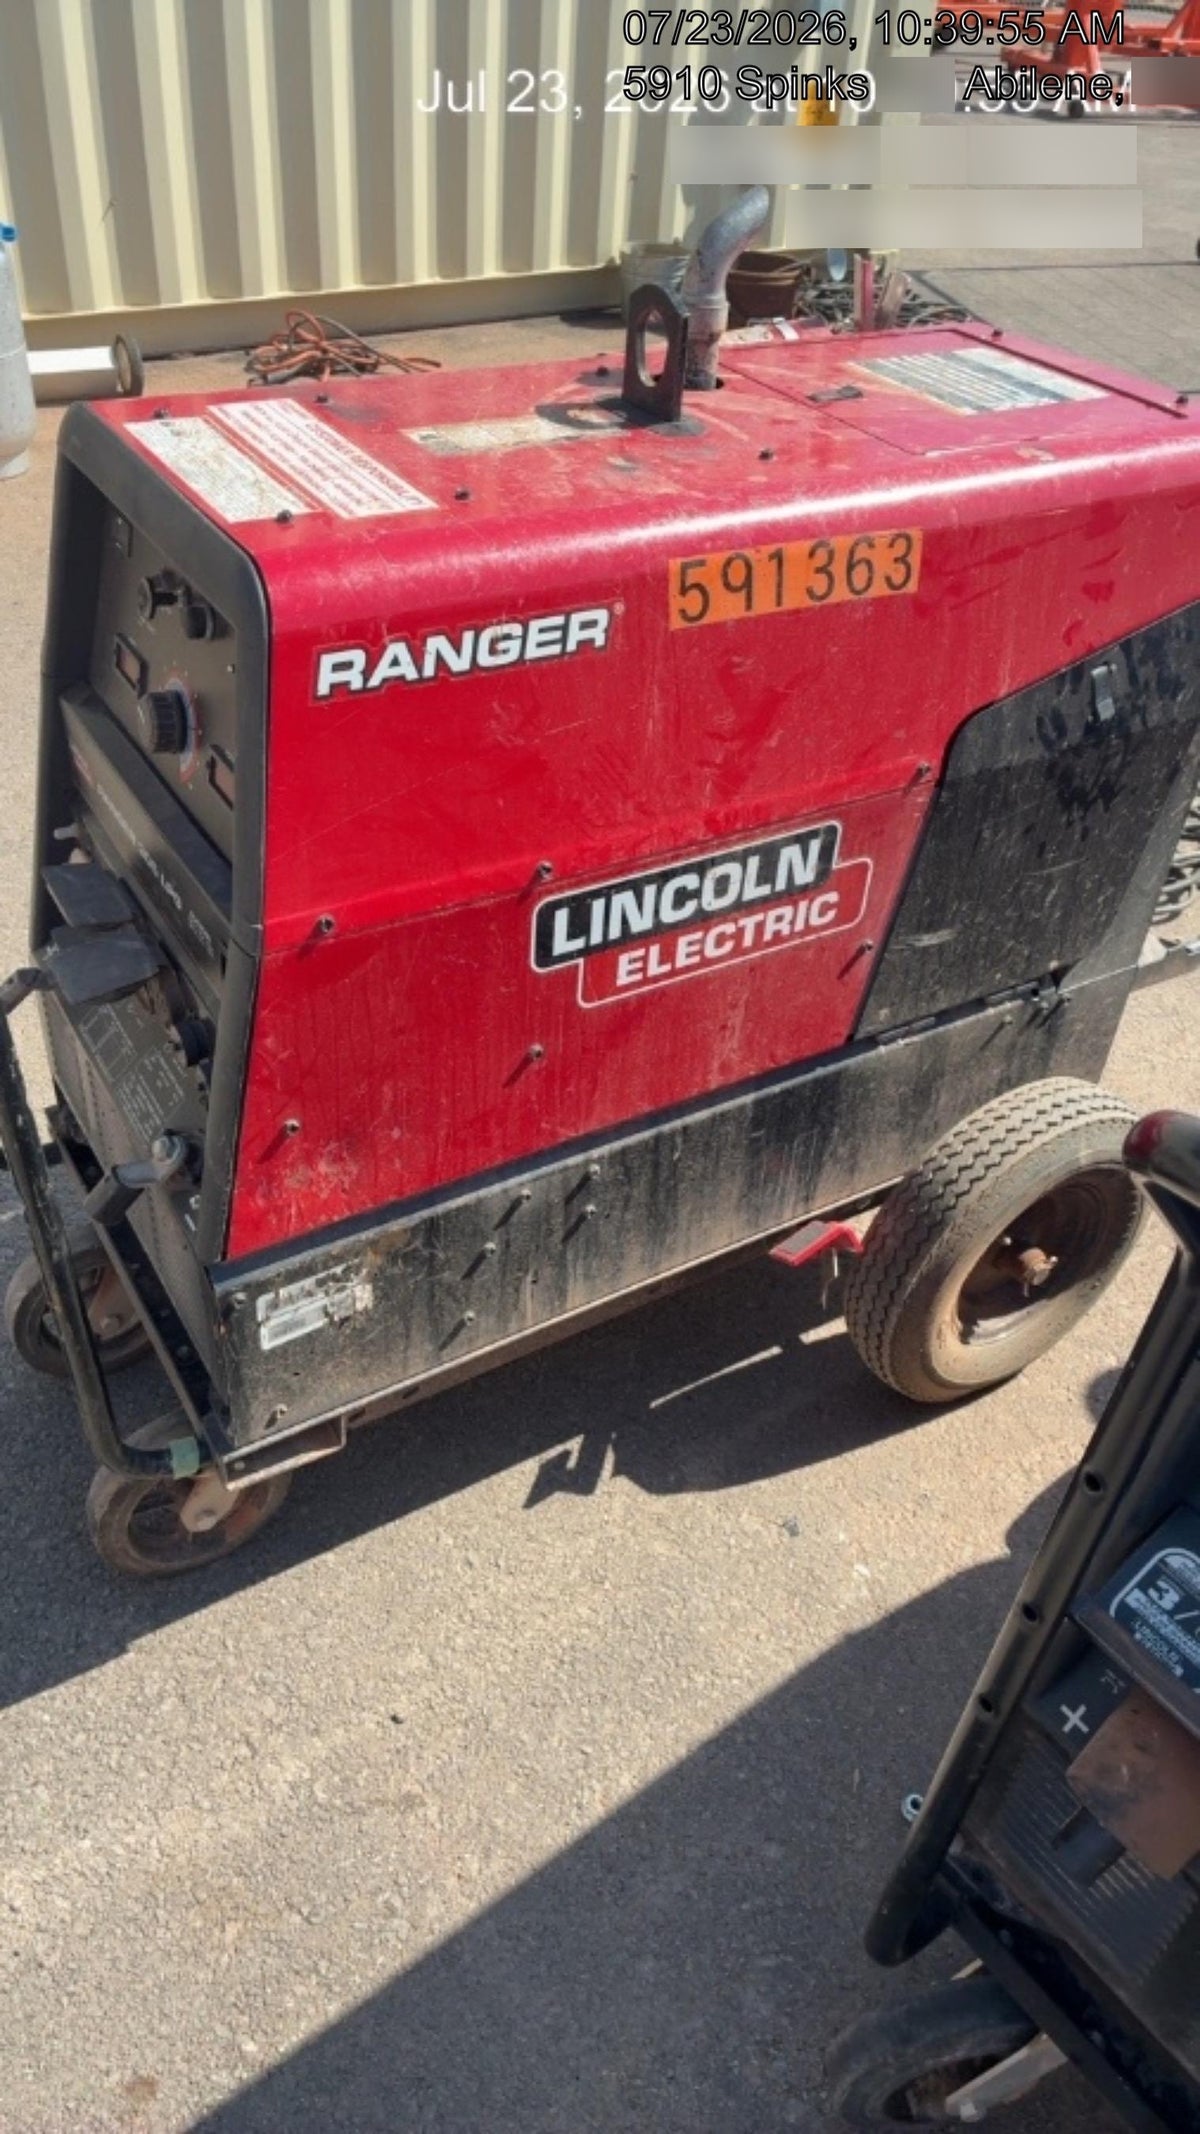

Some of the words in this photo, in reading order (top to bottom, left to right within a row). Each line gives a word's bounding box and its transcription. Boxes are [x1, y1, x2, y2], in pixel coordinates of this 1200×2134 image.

[676, 531, 914, 624] 591363
[315, 606, 612, 697] RANGER
[551, 838, 823, 958] LINCOLN
[615, 892, 840, 987] ELECTRIC
